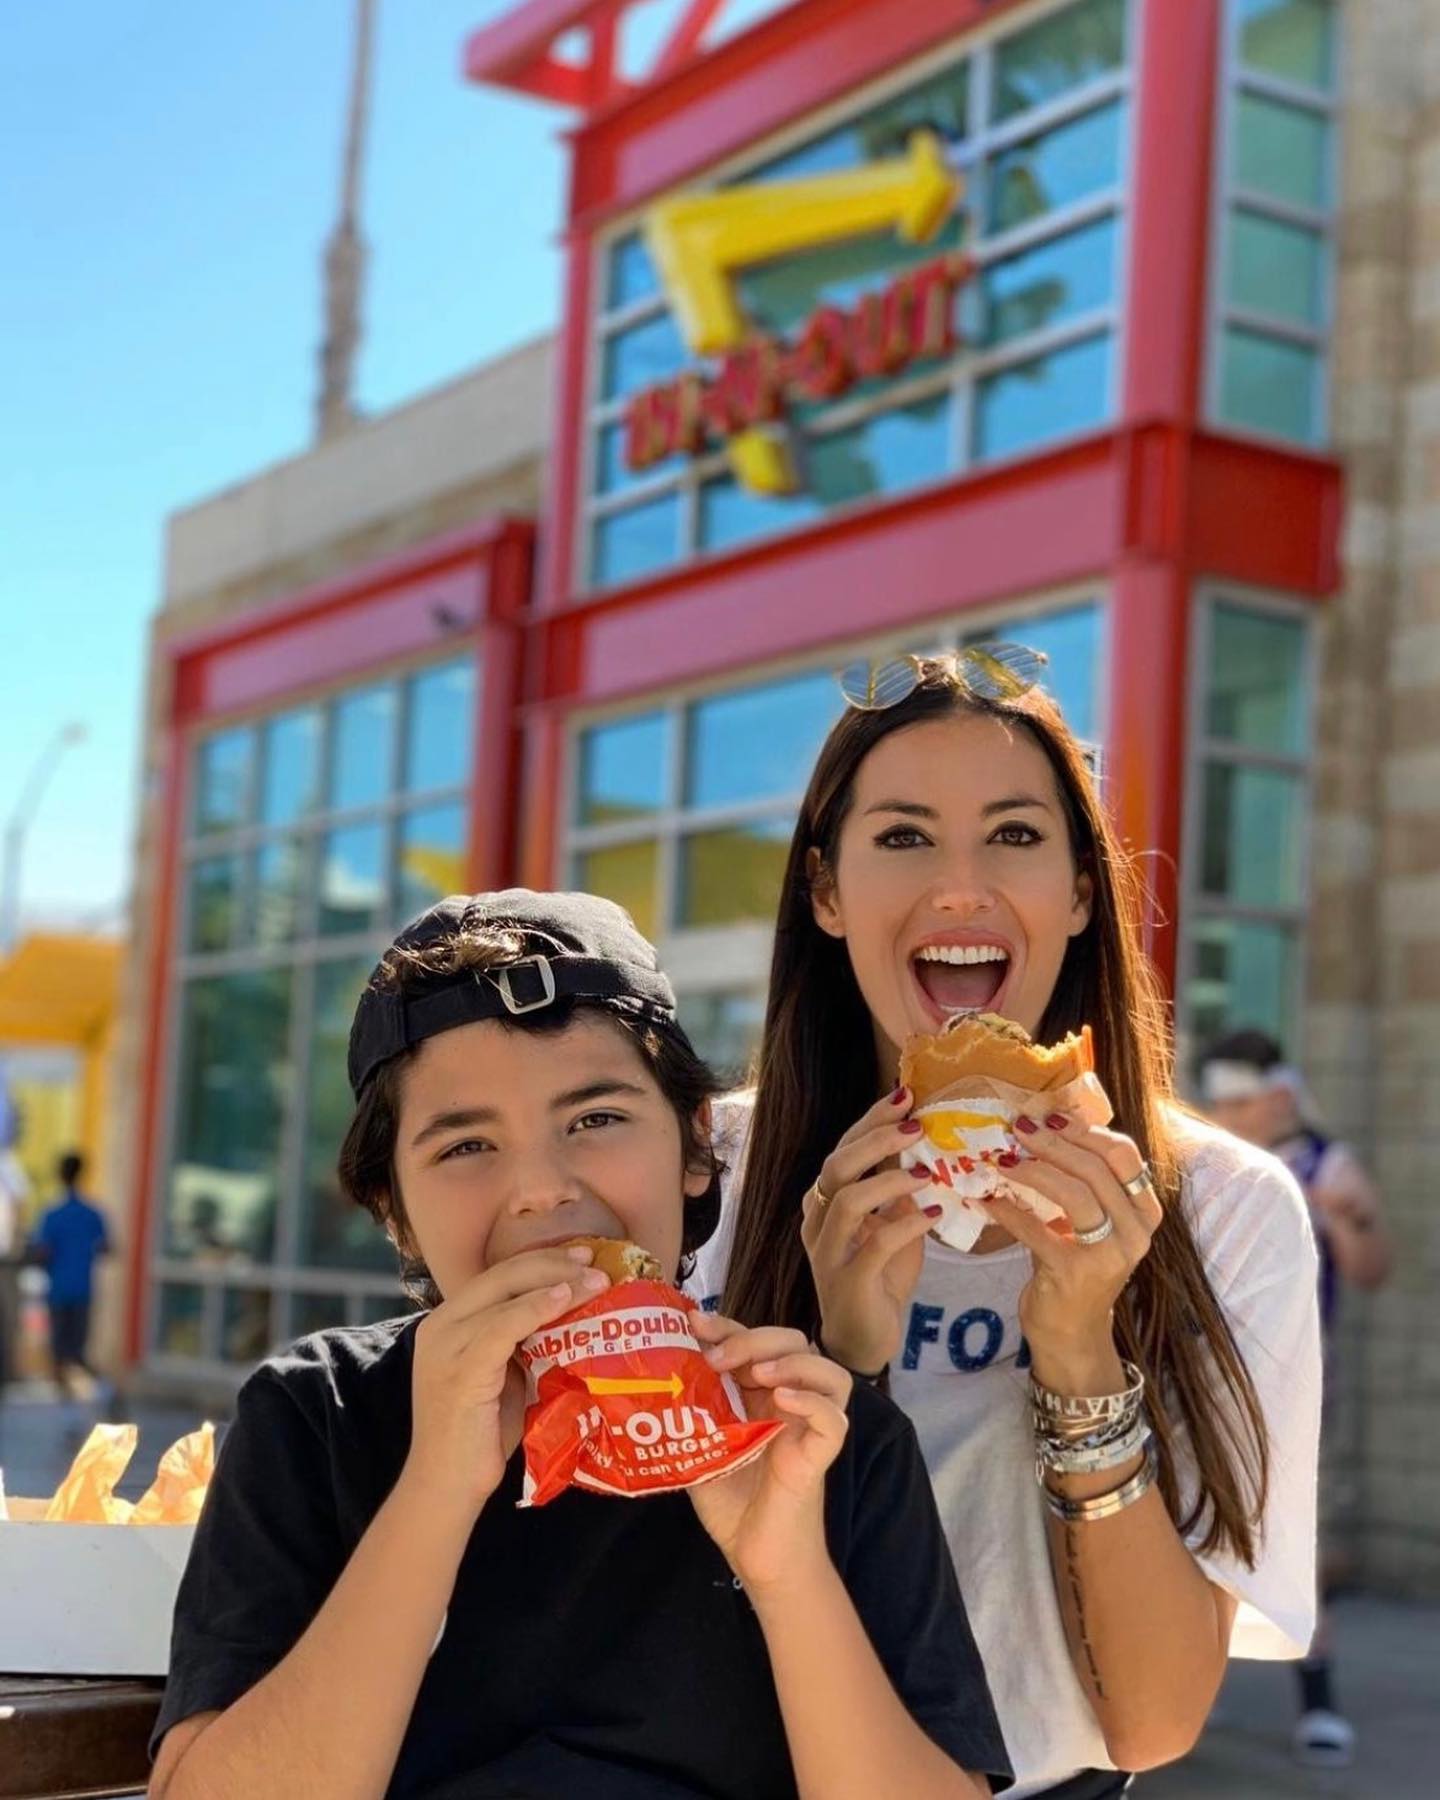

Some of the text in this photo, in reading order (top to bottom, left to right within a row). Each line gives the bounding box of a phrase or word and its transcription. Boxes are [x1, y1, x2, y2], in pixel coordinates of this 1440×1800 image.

[622, 252, 972, 473] IN-N-OUT
[522, 1312, 693, 1367] ouble-Doubl
[635, 1431, 727, 1461] BURGER
